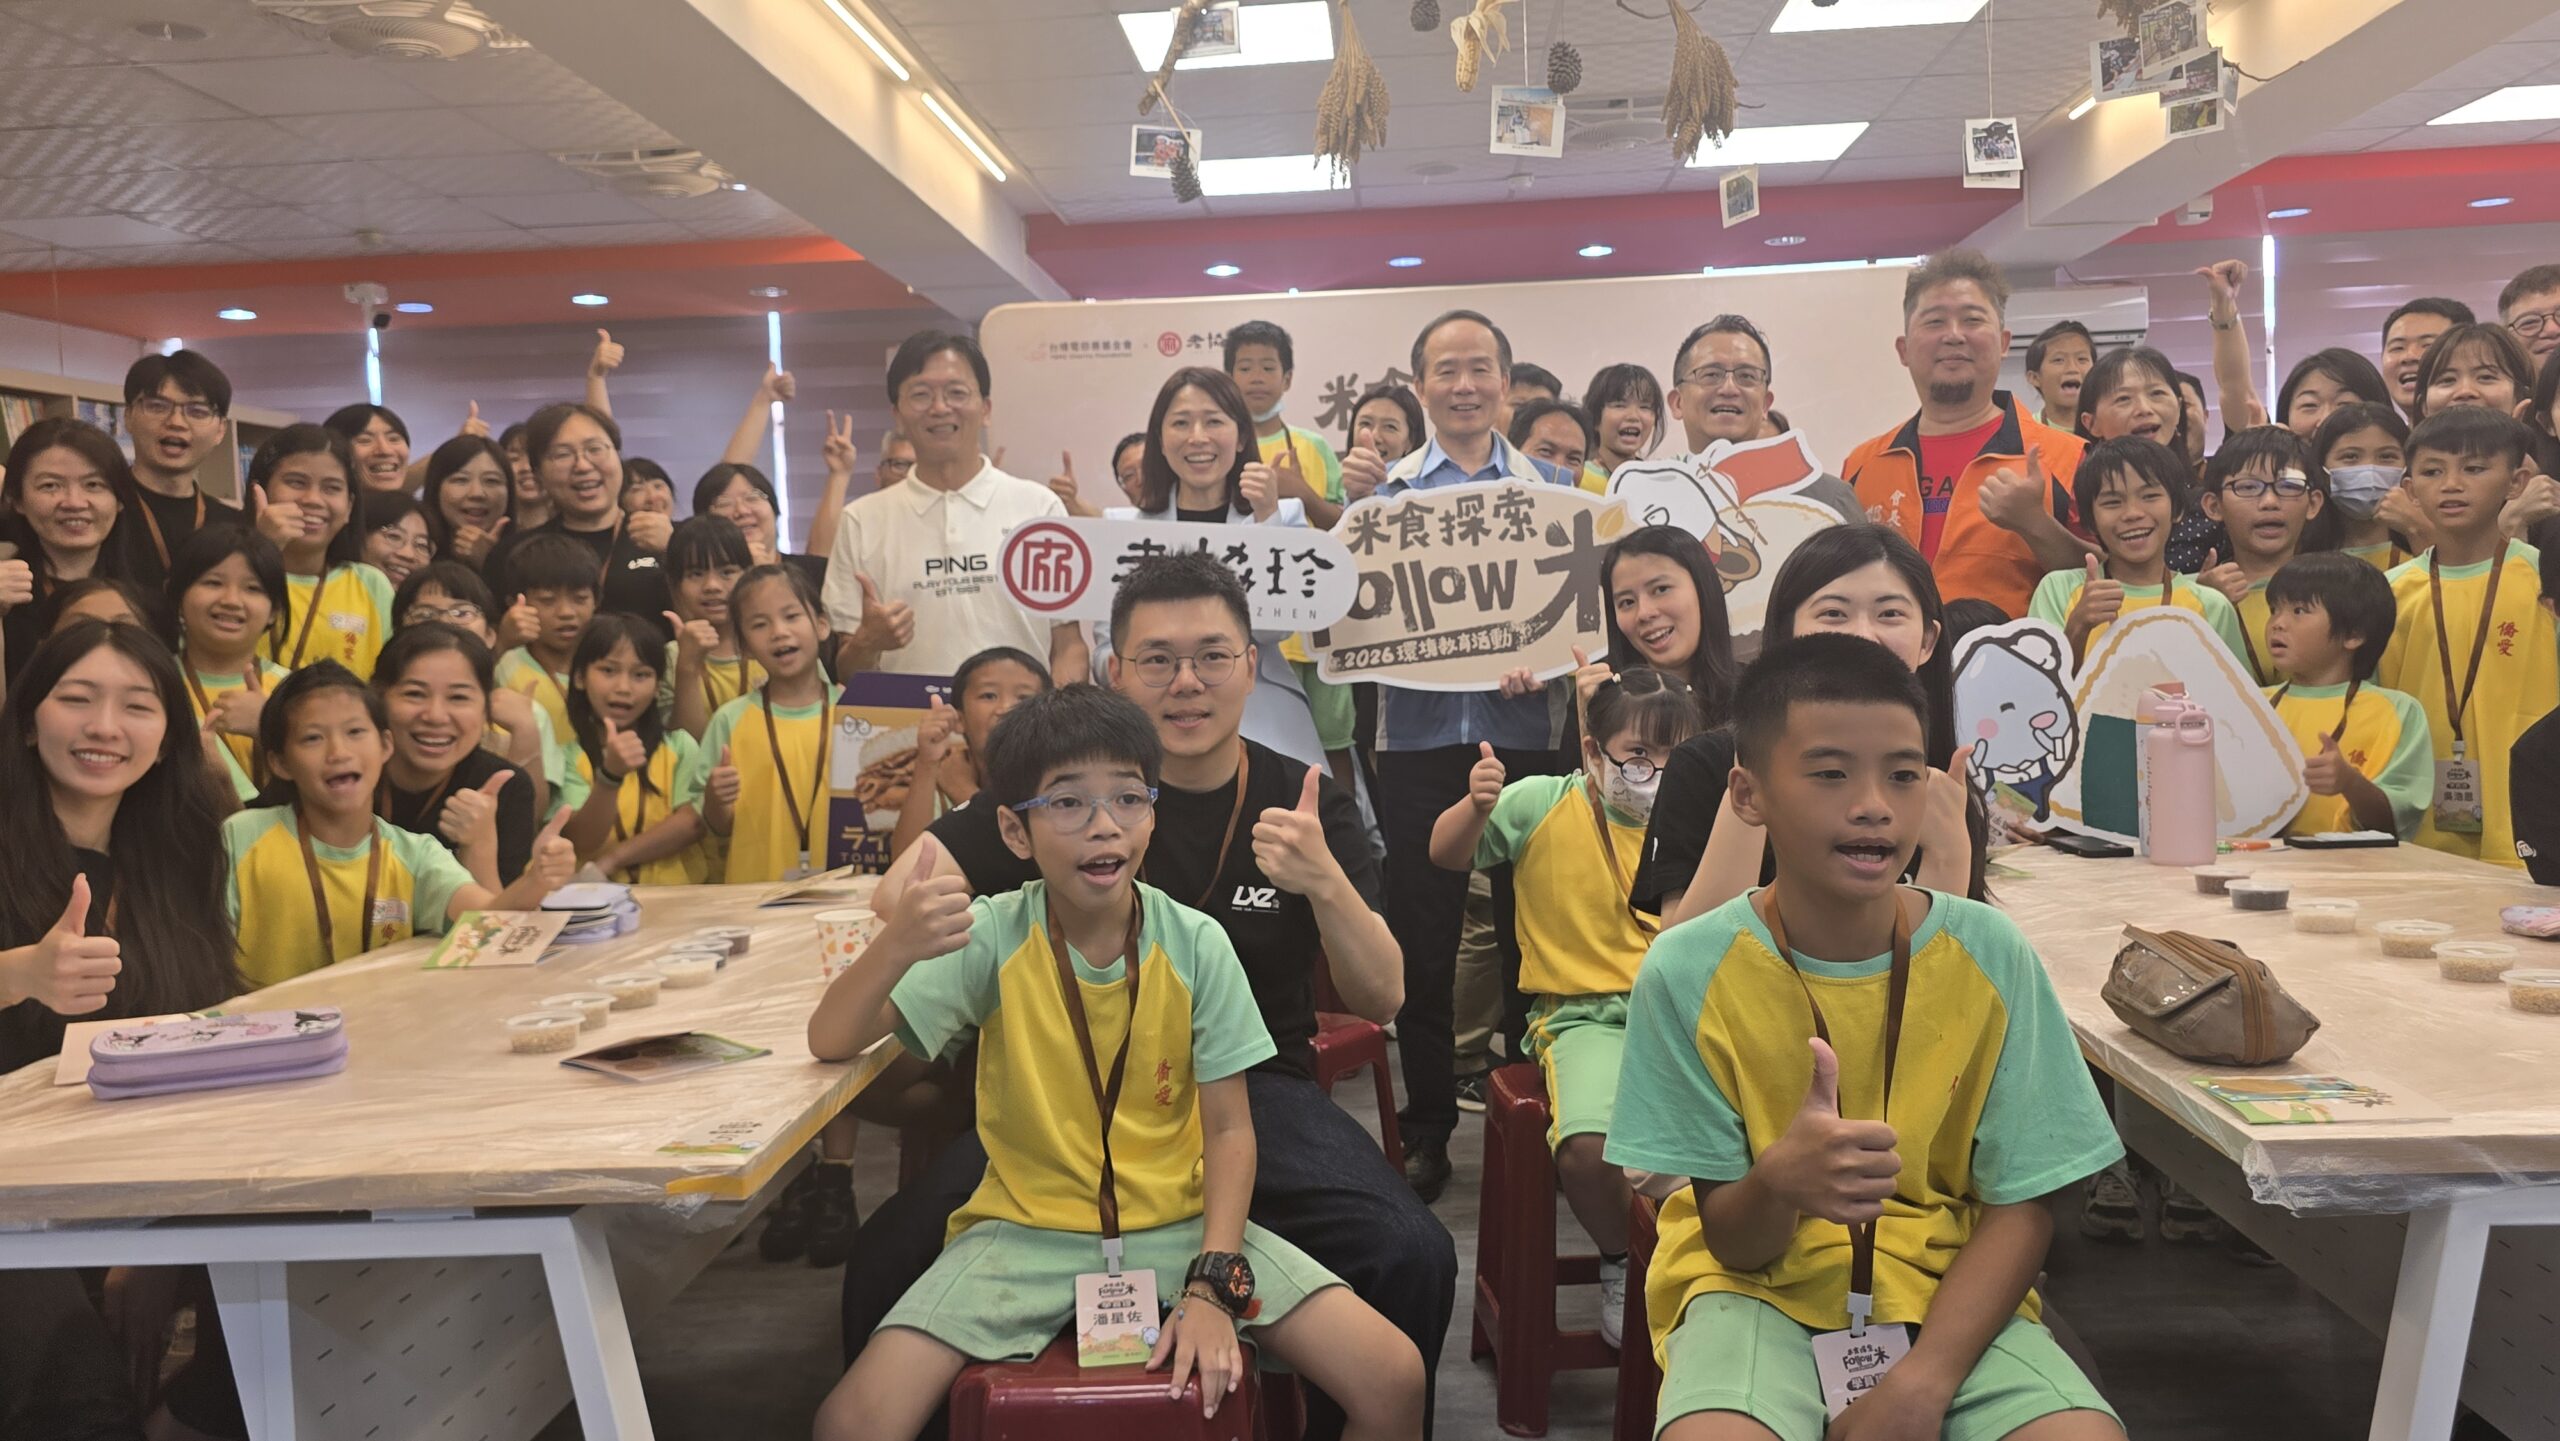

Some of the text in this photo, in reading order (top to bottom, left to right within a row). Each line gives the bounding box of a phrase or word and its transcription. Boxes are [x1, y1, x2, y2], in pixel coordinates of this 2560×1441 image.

[1347, 487, 1538, 555] 米食探索
[925, 554, 988, 576] PING
[1312, 559, 1518, 648] ollow
[2497, 621, 2519, 657] 僑愛
[1153, 1058, 1173, 1107] 僑愛
